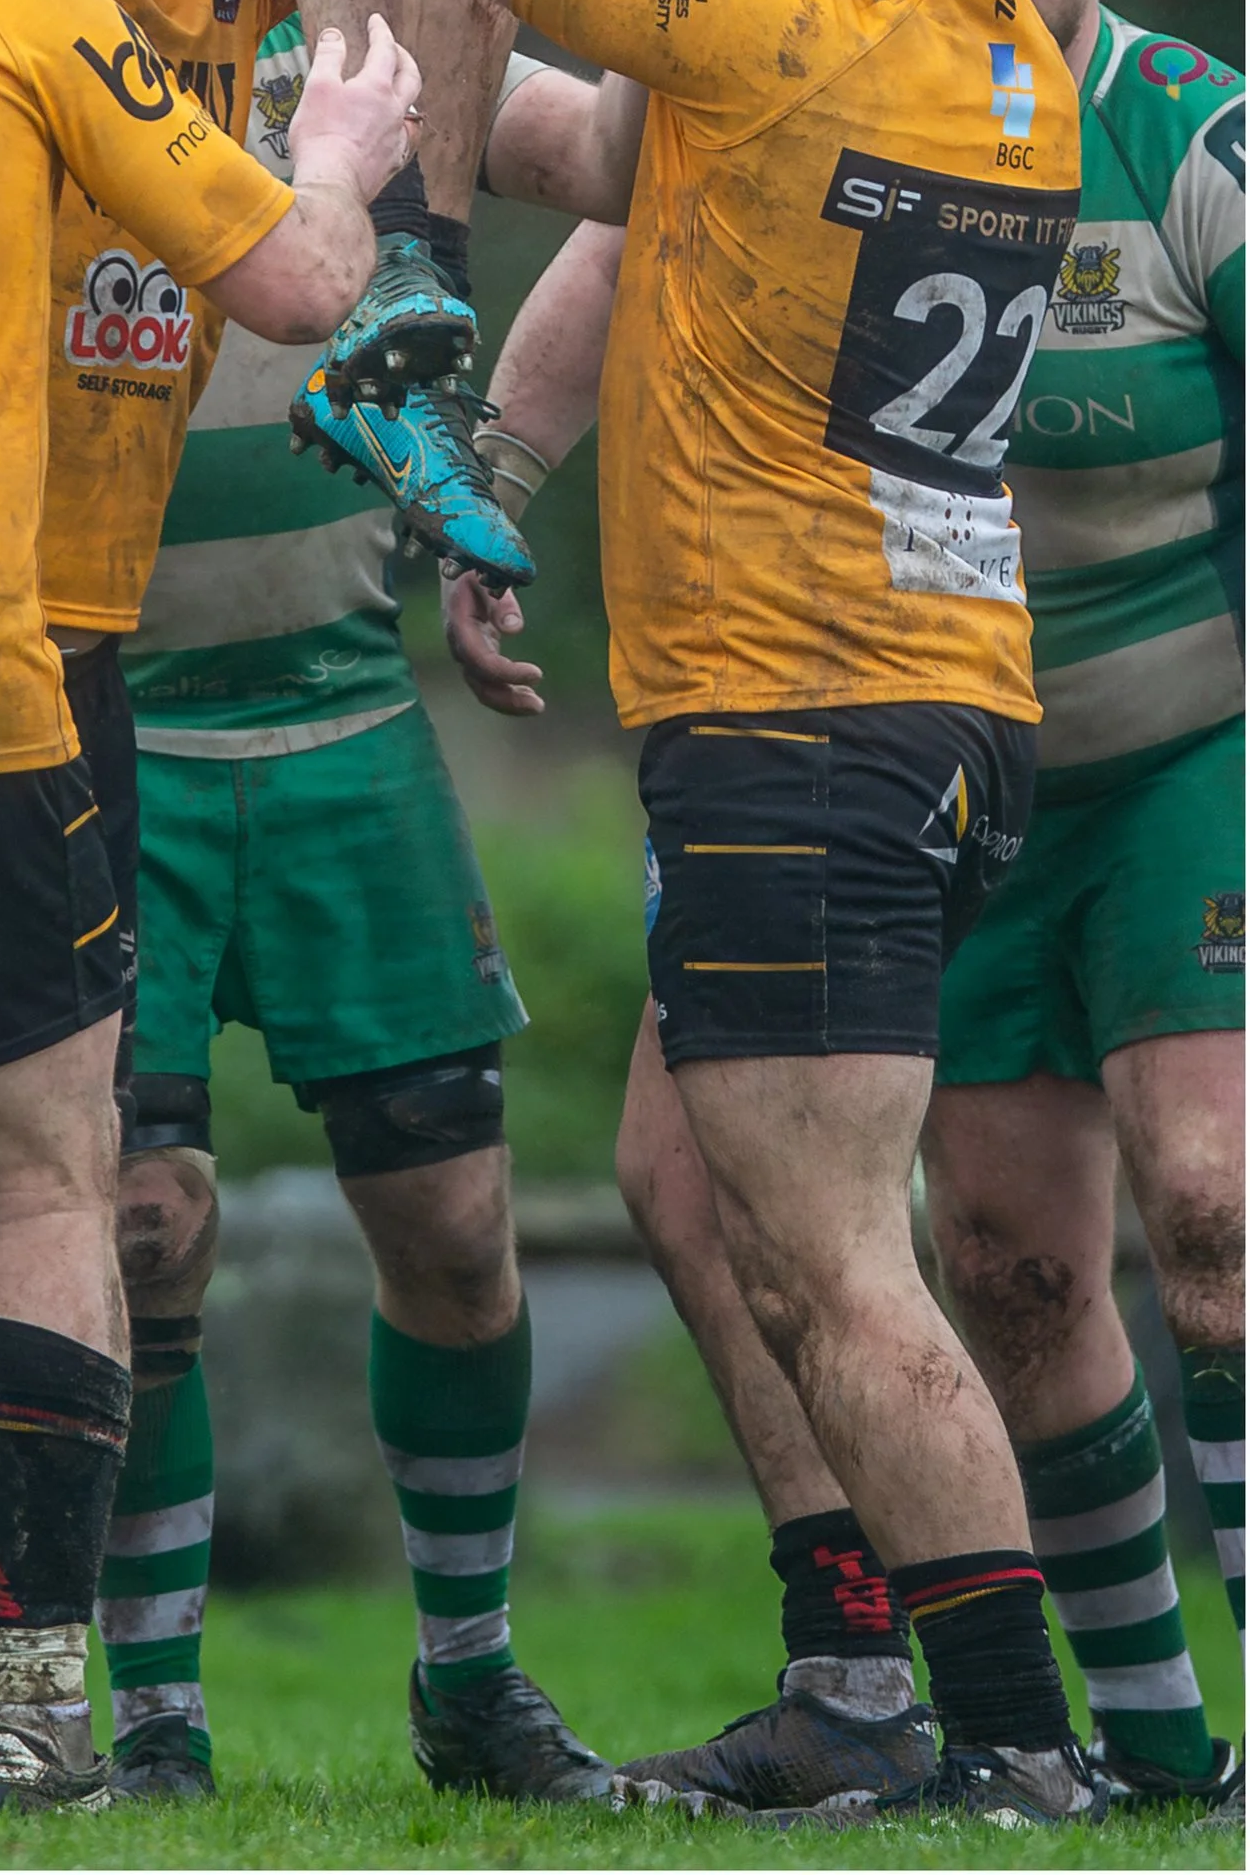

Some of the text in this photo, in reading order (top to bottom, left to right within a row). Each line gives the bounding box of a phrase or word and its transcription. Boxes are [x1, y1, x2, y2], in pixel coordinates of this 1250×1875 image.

[996, 142, 1035, 170] BGC
[937, 202, 1030, 242] SPORT
[1035, 217, 1055, 245] IT
[1053, 302, 1124, 327] VIKINGS
[71, 312, 191, 364] LOOK
[868, 272, 1048, 468] 22
[111, 378, 172, 401] STORAGE
